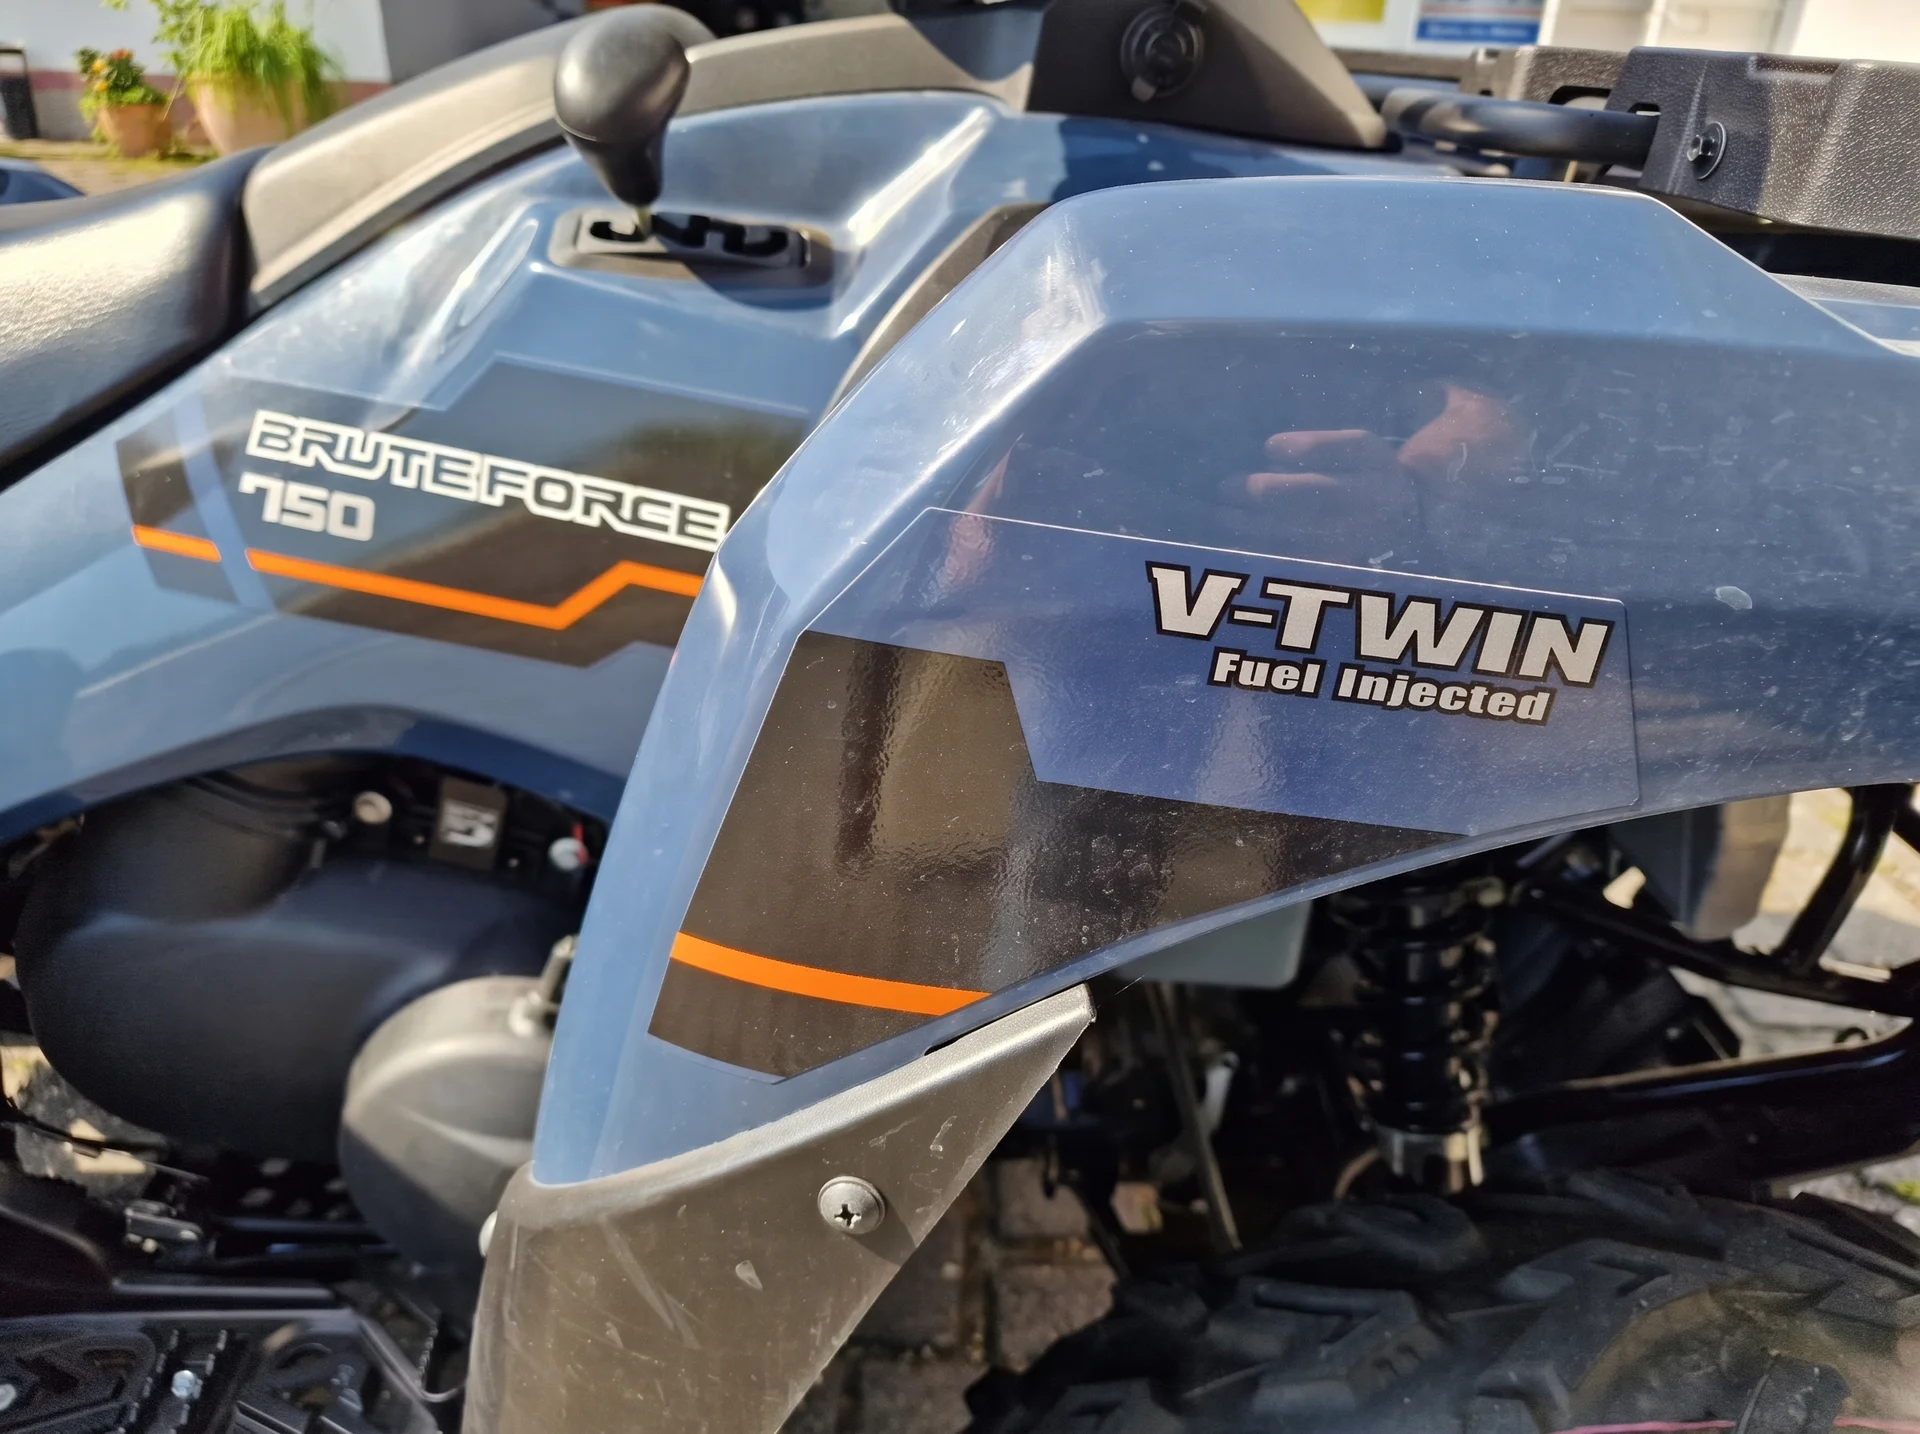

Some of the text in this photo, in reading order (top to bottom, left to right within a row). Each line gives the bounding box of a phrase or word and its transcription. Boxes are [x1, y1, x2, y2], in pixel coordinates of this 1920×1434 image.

[238, 471, 376, 542] 750
[1147, 561, 1614, 688] V-TWIN
[1209, 648, 1555, 725] Fuel Injected
